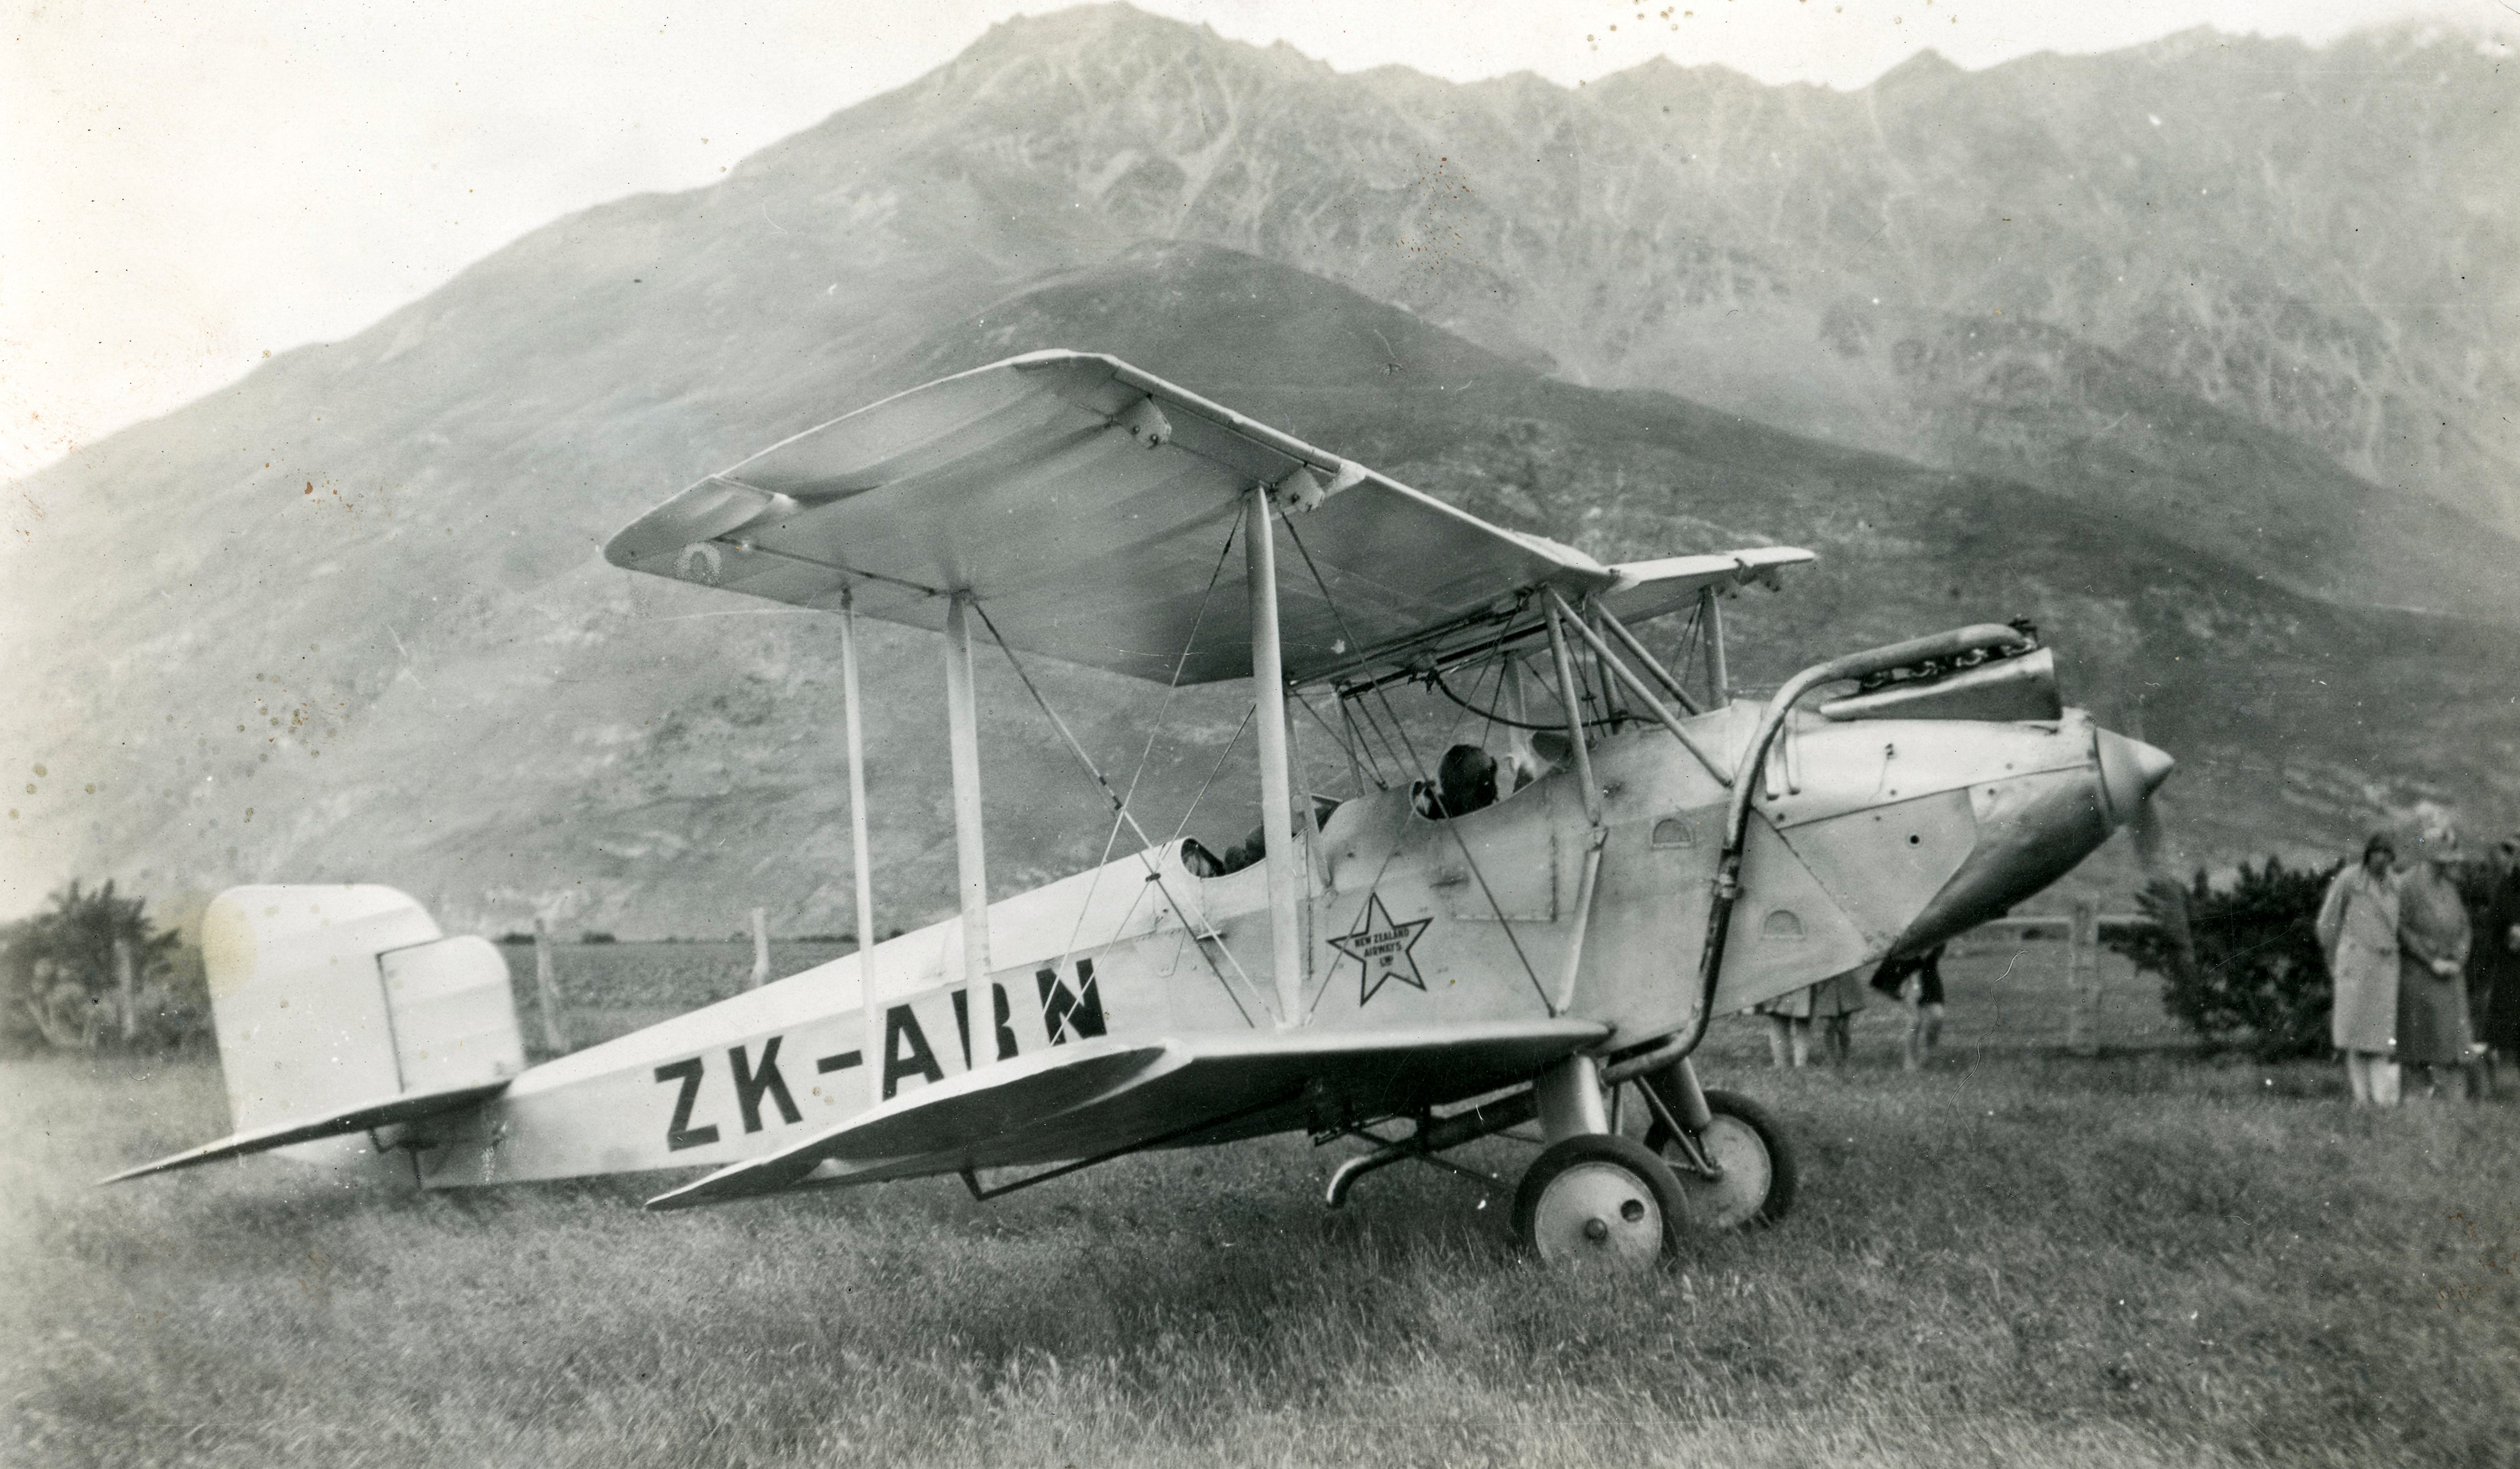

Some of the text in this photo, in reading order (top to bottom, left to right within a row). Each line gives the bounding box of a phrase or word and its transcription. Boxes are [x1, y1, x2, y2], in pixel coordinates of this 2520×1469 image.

[1354, 928, 1409, 947] NEW ZEALAND
[1364, 941, 1402, 958] AIRWAYS
